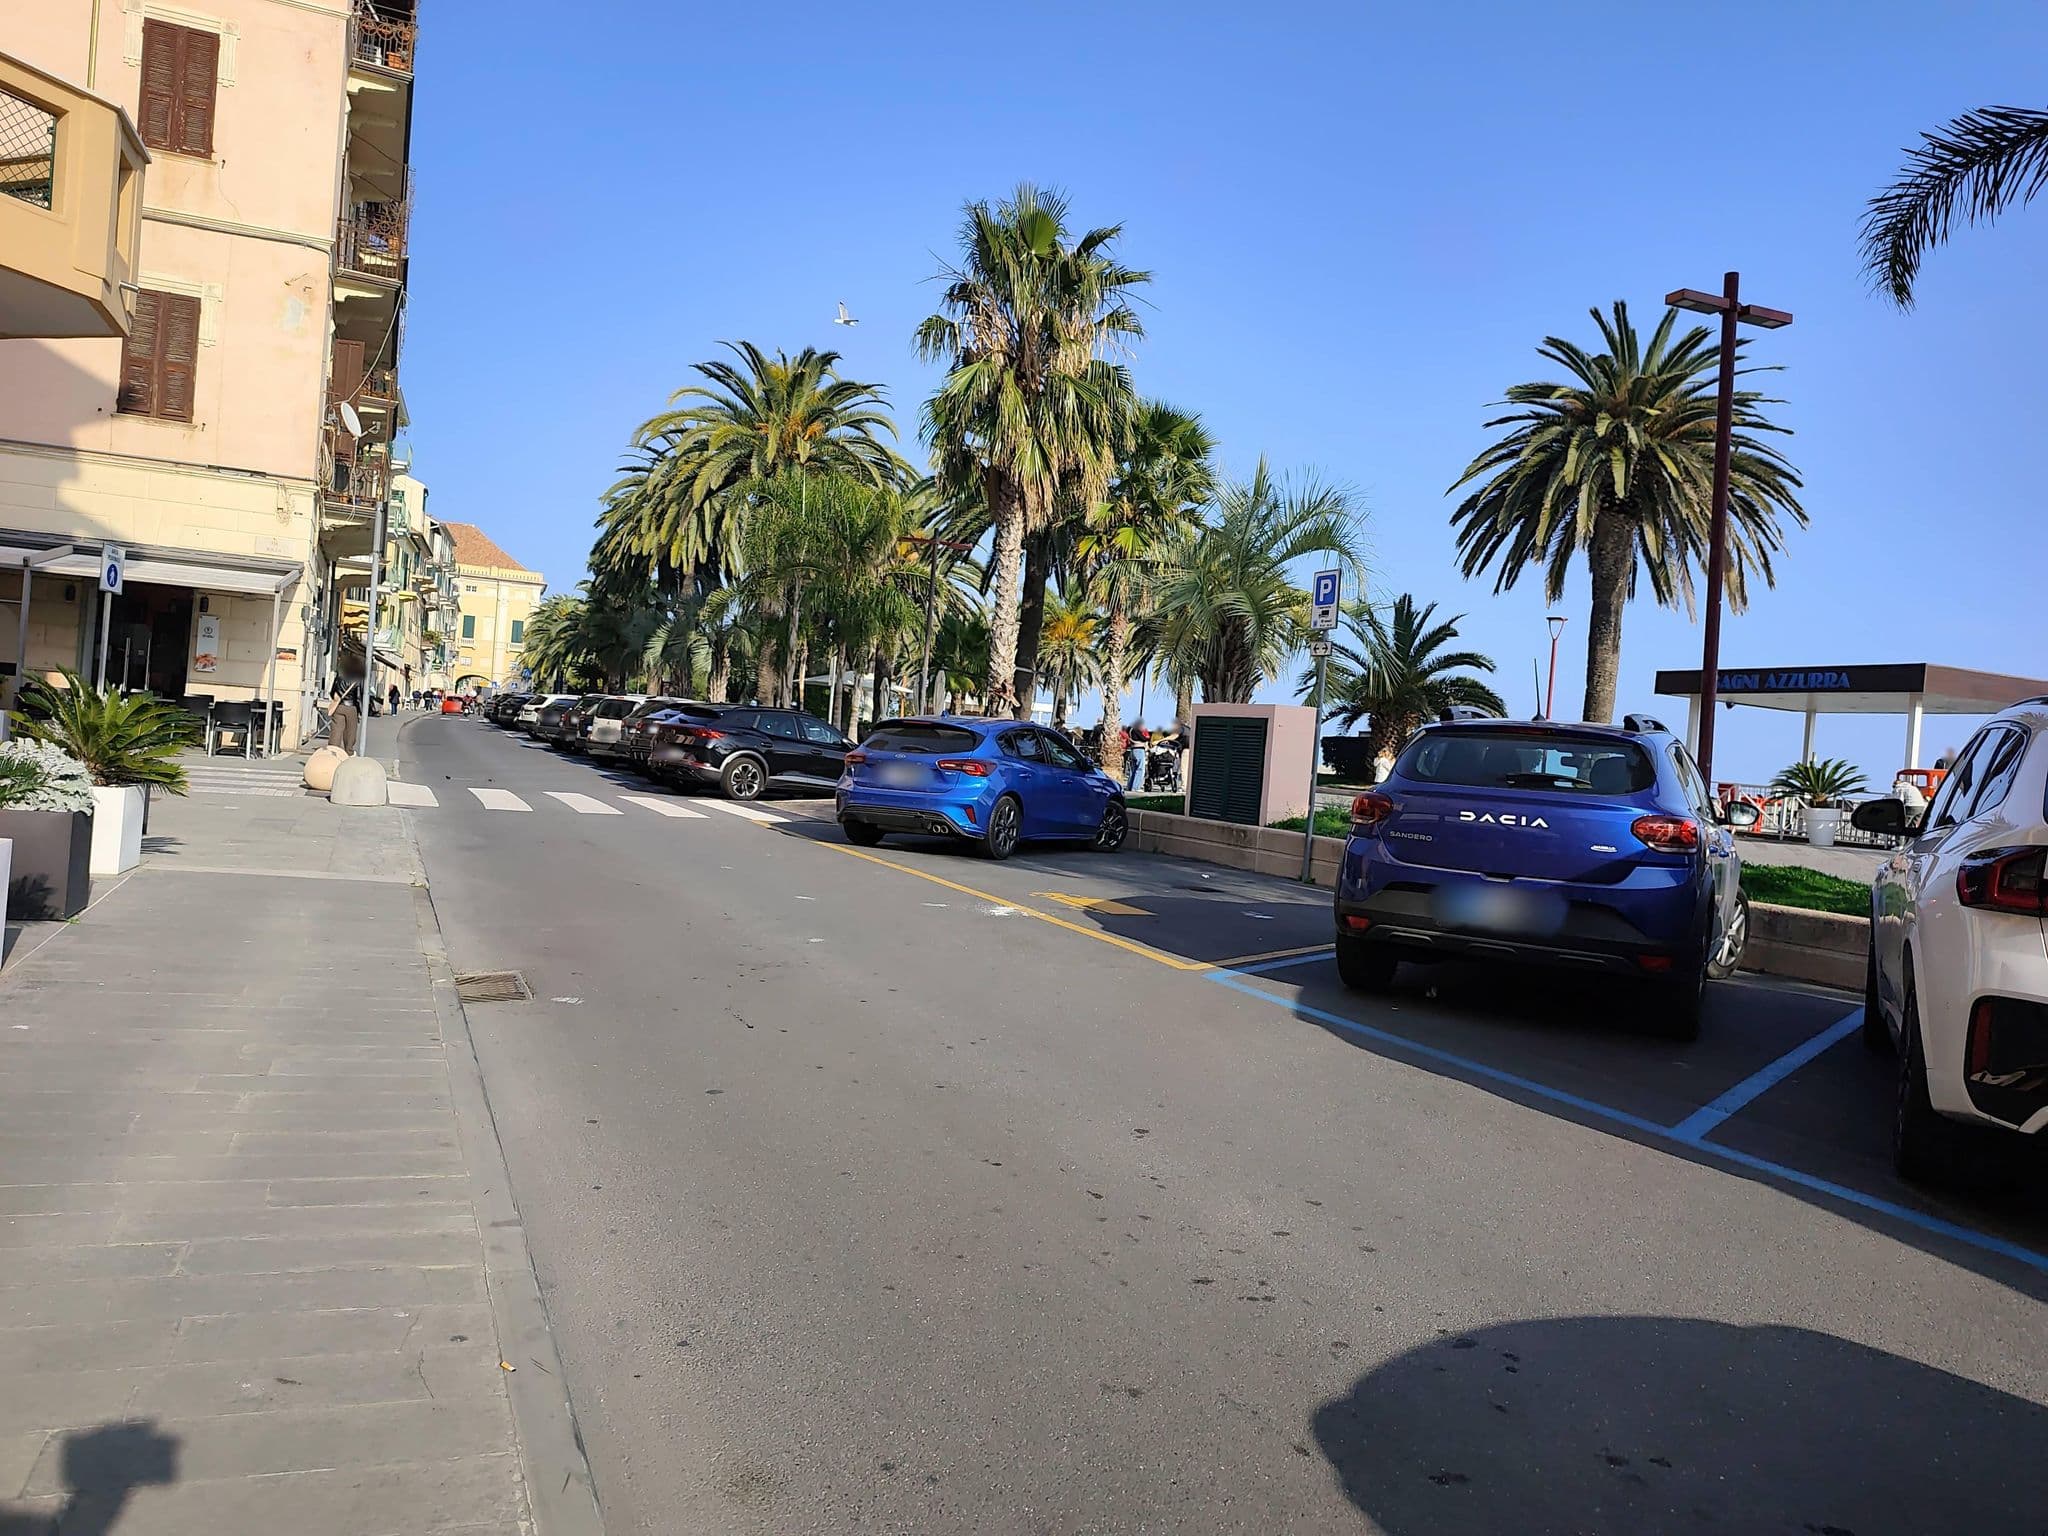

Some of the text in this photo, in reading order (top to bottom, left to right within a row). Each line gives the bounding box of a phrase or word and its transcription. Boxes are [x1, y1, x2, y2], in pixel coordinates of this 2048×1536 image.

[1320, 579, 1332, 602] P
[1765, 671, 1851, 689] AZZURRA
[1459, 810, 1549, 828] DACIA
[1389, 830, 1433, 842] SANDERO
